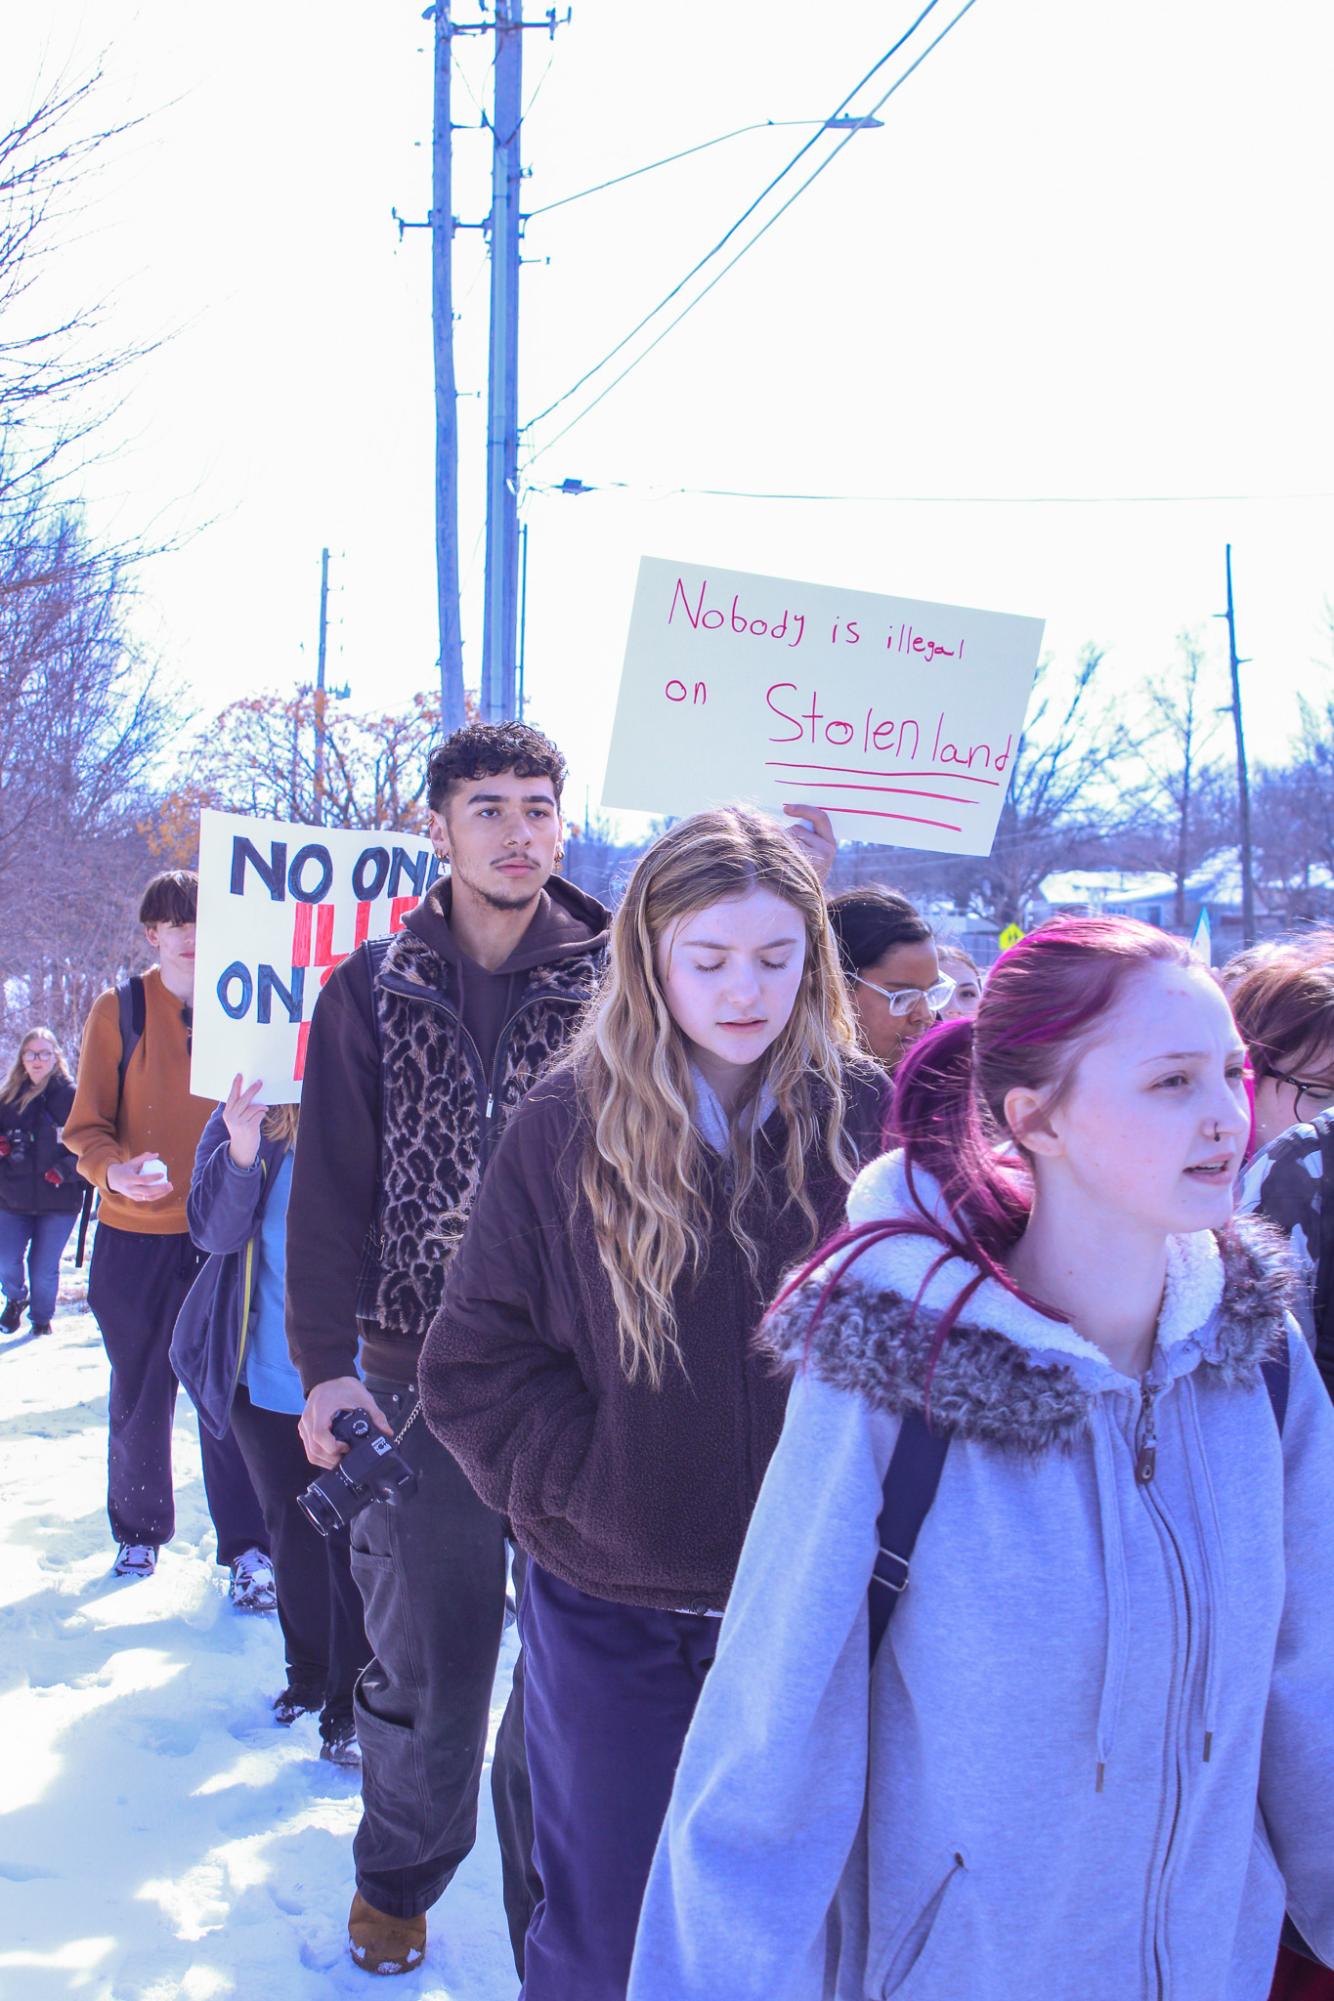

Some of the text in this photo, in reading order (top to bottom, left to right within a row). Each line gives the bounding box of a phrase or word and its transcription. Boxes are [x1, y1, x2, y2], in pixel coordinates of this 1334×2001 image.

[668, 577, 965, 662] Nobody is illegal
[664, 679, 708, 705] on
[229, 835, 334, 905] NO
[216, 960, 306, 1024] ON
